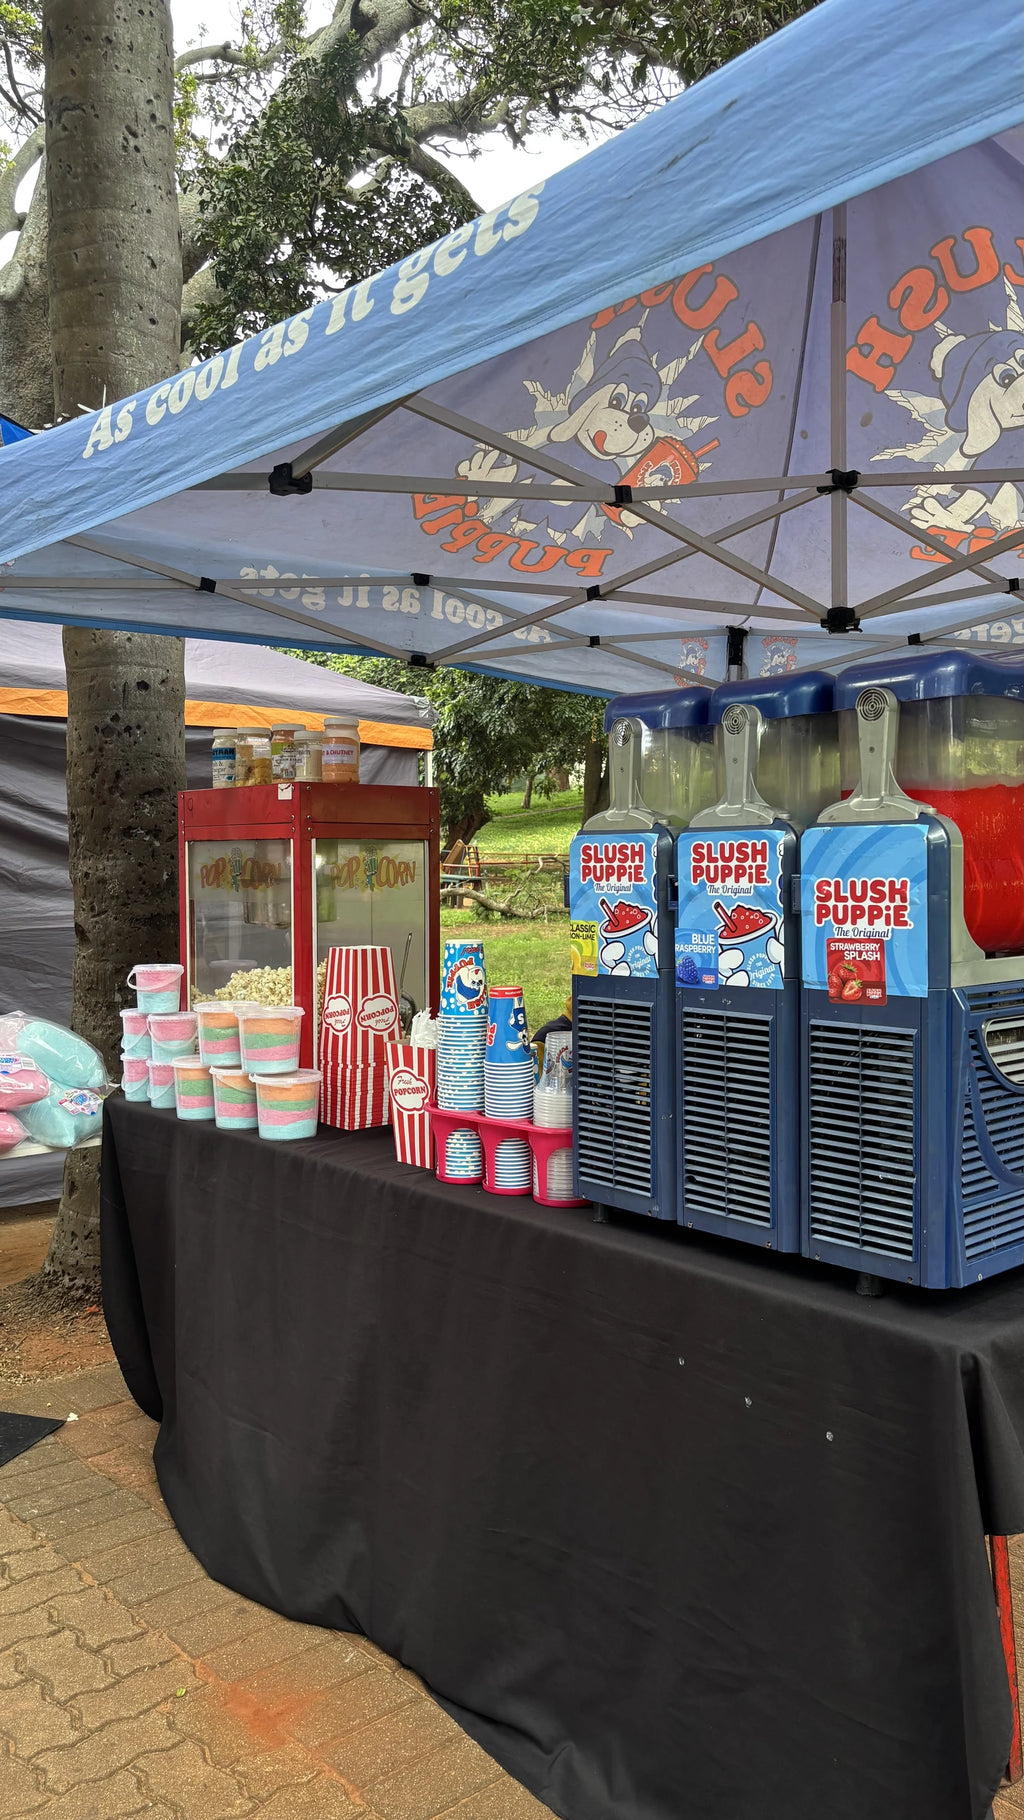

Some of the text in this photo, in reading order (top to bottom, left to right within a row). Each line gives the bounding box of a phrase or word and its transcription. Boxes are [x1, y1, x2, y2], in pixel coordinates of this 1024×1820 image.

[82, 400, 136, 458] As
[146, 340, 246, 426] cool
[254, 307, 314, 371] as
[391, 182, 546, 316] gets
[581, 843, 645, 864] SLUSH
[691, 841, 768, 865] SLUSH
[200, 857, 282, 890] POP CORN
[330, 856, 416, 889] POP CORN
[595, 883, 632, 894] The Original
[707, 884, 753, 897] The Original
[815, 878, 909, 904] SLUSH
[692, 934, 715, 944] BLUE
[834, 926, 890, 941] The Original
[675, 944, 717, 954] RASPBERRY
[830, 942, 880, 951] STRAWBERRY
[844, 951, 880, 961] SPLASH
[325, 1008, 349, 1020] POPCORN
[361, 1006, 394, 1023] POPCORN
[394, 1086, 426, 1097] POPCORN
